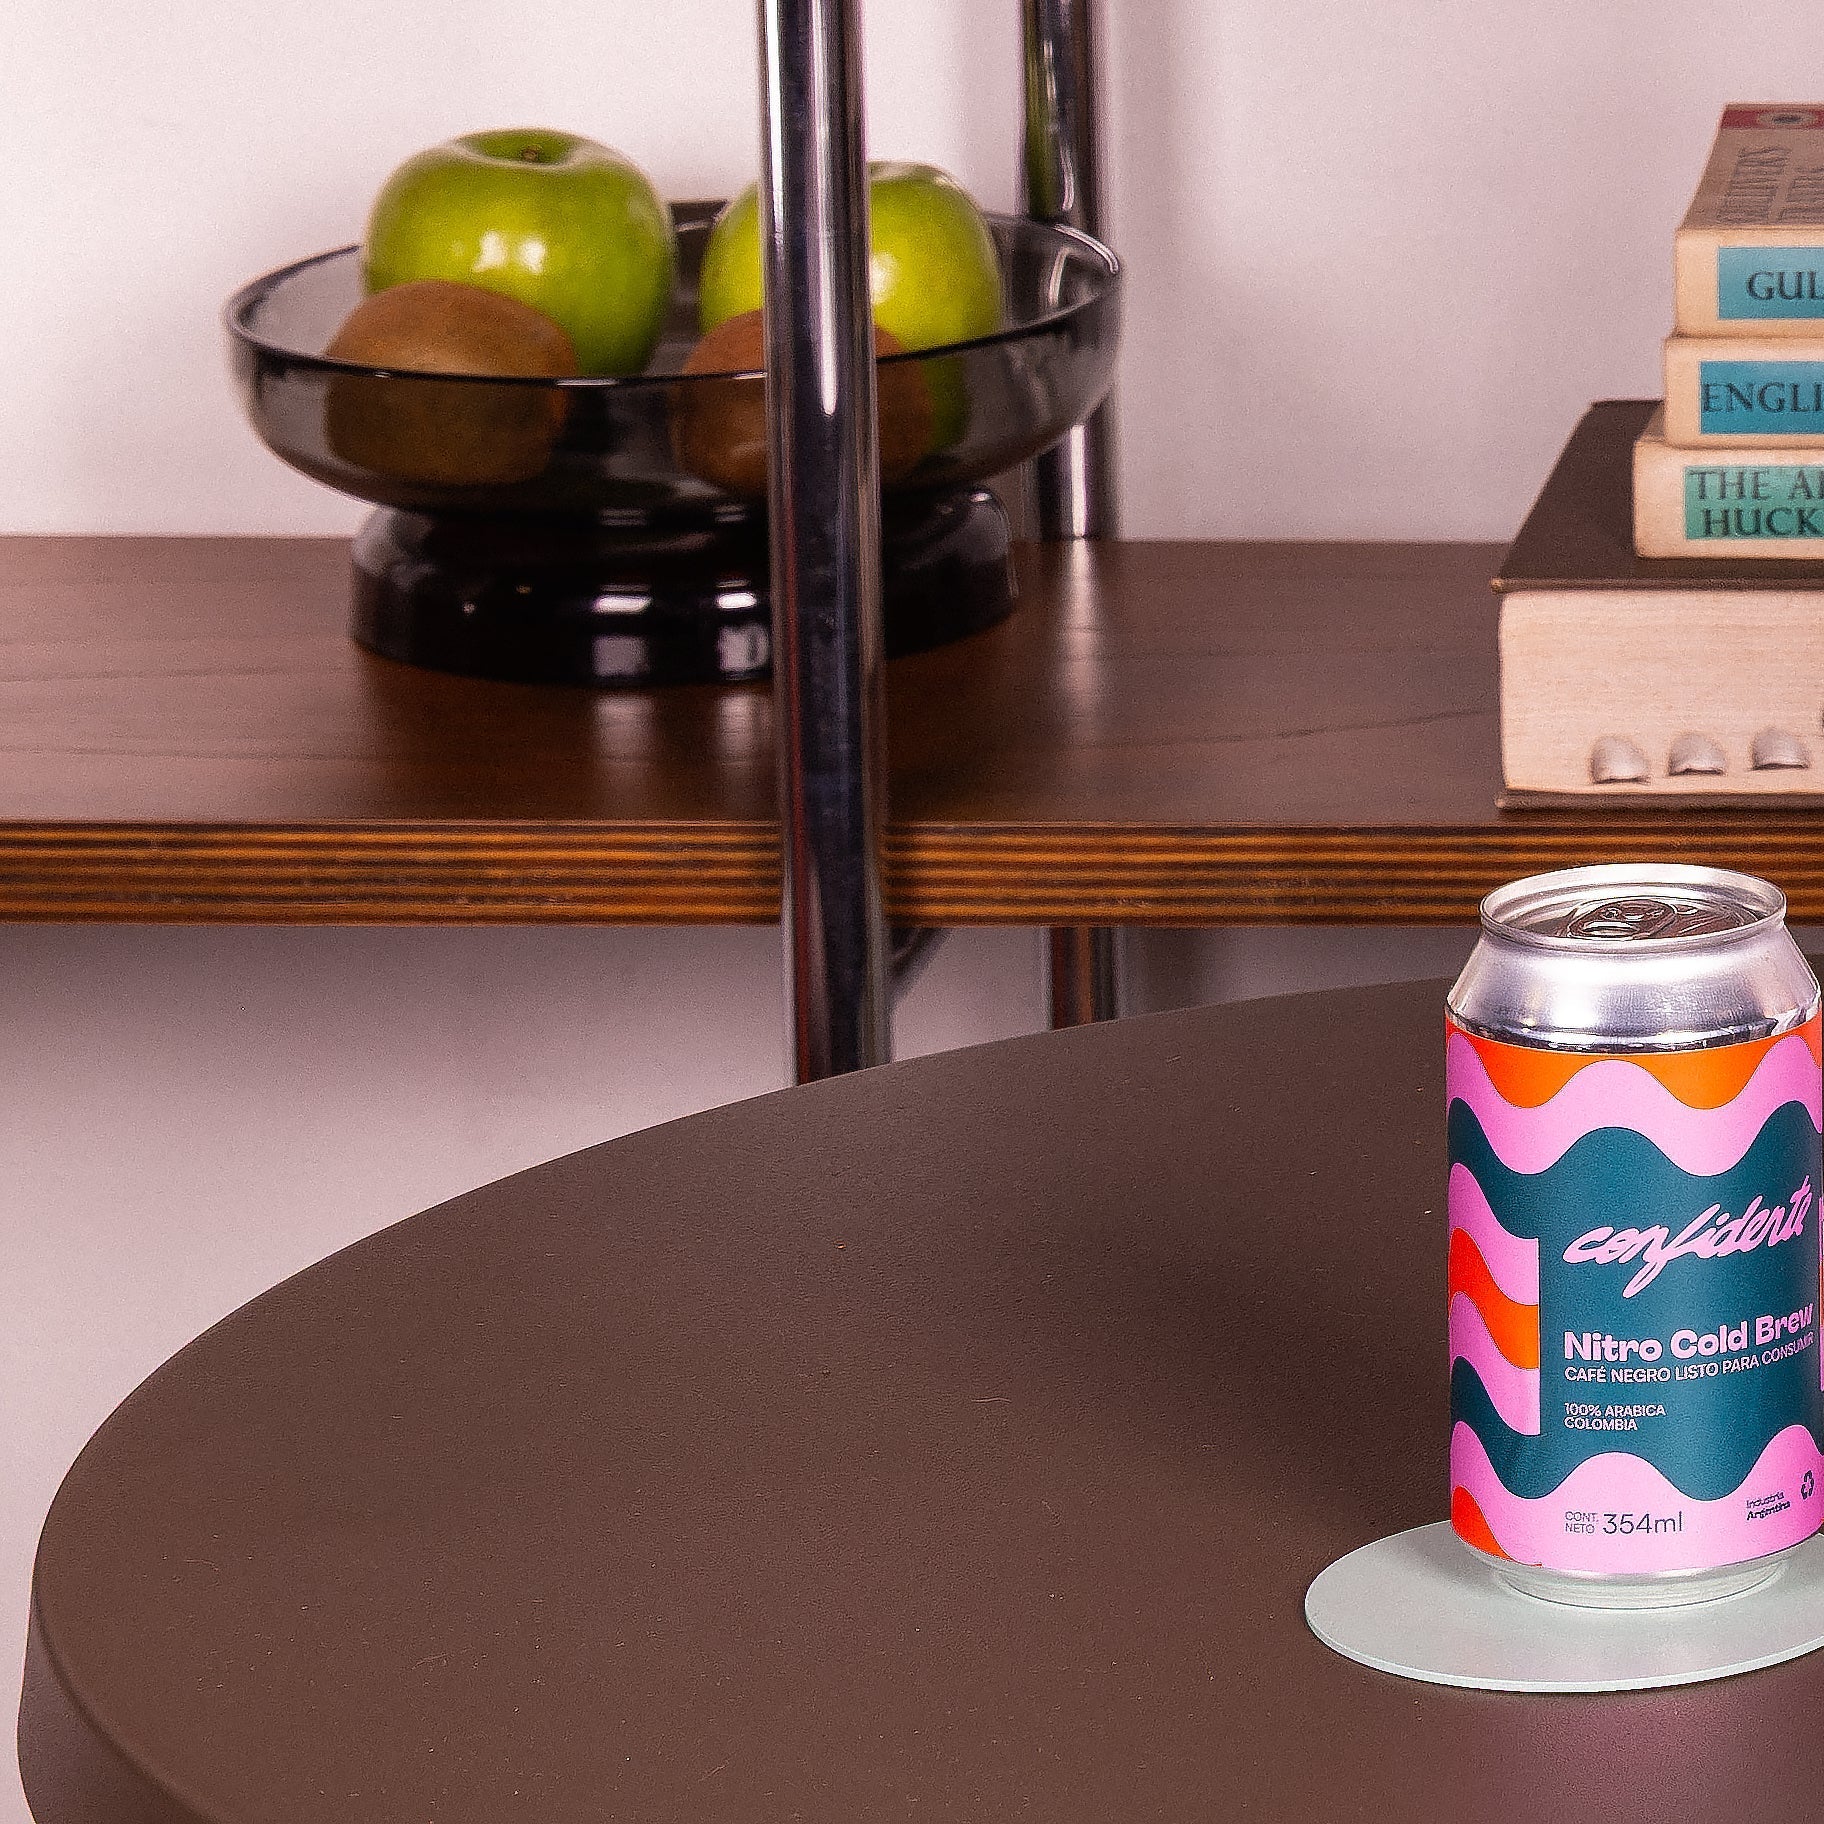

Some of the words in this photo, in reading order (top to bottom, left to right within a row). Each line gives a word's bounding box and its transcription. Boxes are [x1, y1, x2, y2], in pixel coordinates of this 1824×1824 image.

[1687, 468, 1776, 502] THE
[1563, 1330, 1663, 1363] Nitro
[1670, 1320, 1749, 1361] Cold
[1755, 1303, 1814, 1347] Brew
[1564, 1365, 1608, 1384] CAFÉ
[1611, 1366, 1672, 1384] NEGRO
[1674, 1360, 1720, 1382] LISTO
[1722, 1353, 1761, 1375] PARA
[1761, 1330, 1816, 1366] CONSUMIR
[1564, 1402, 1602, 1417] 100%
[1604, 1404, 1667, 1418] ARABICA
[1563, 1417, 1639, 1432] COLOMBIA
[1745, 1490, 1786, 1509] Industria
[1564, 1510, 1600, 1523] CONT.
[1746, 1501, 1792, 1522] Argentina
[1564, 1522, 1596, 1535] NETO
[1602, 1511, 1683, 1535] 354ml
